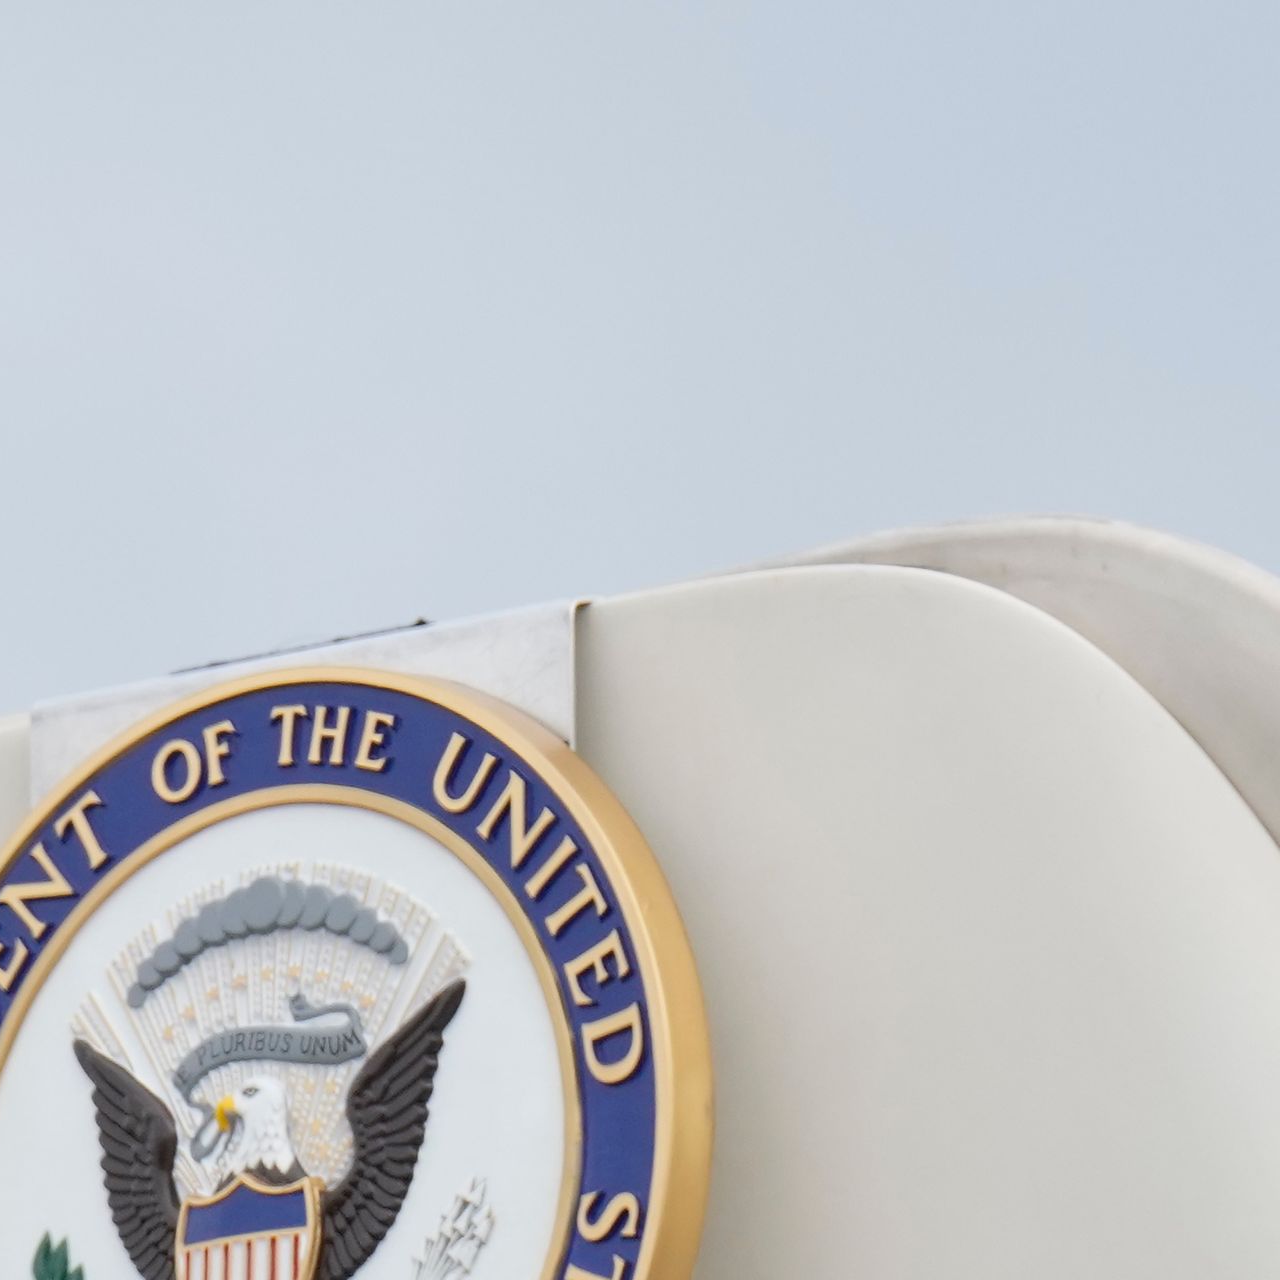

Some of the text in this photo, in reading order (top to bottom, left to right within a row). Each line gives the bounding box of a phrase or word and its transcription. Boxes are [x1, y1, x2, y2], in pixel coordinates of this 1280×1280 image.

[151, 718, 239, 803] OF
[269, 703, 396, 773] THE
[432, 733, 644, 1088] UNITED
[198, 1031, 293, 1066] PLURIBUS
[299, 1027, 361, 1056] UNUM
